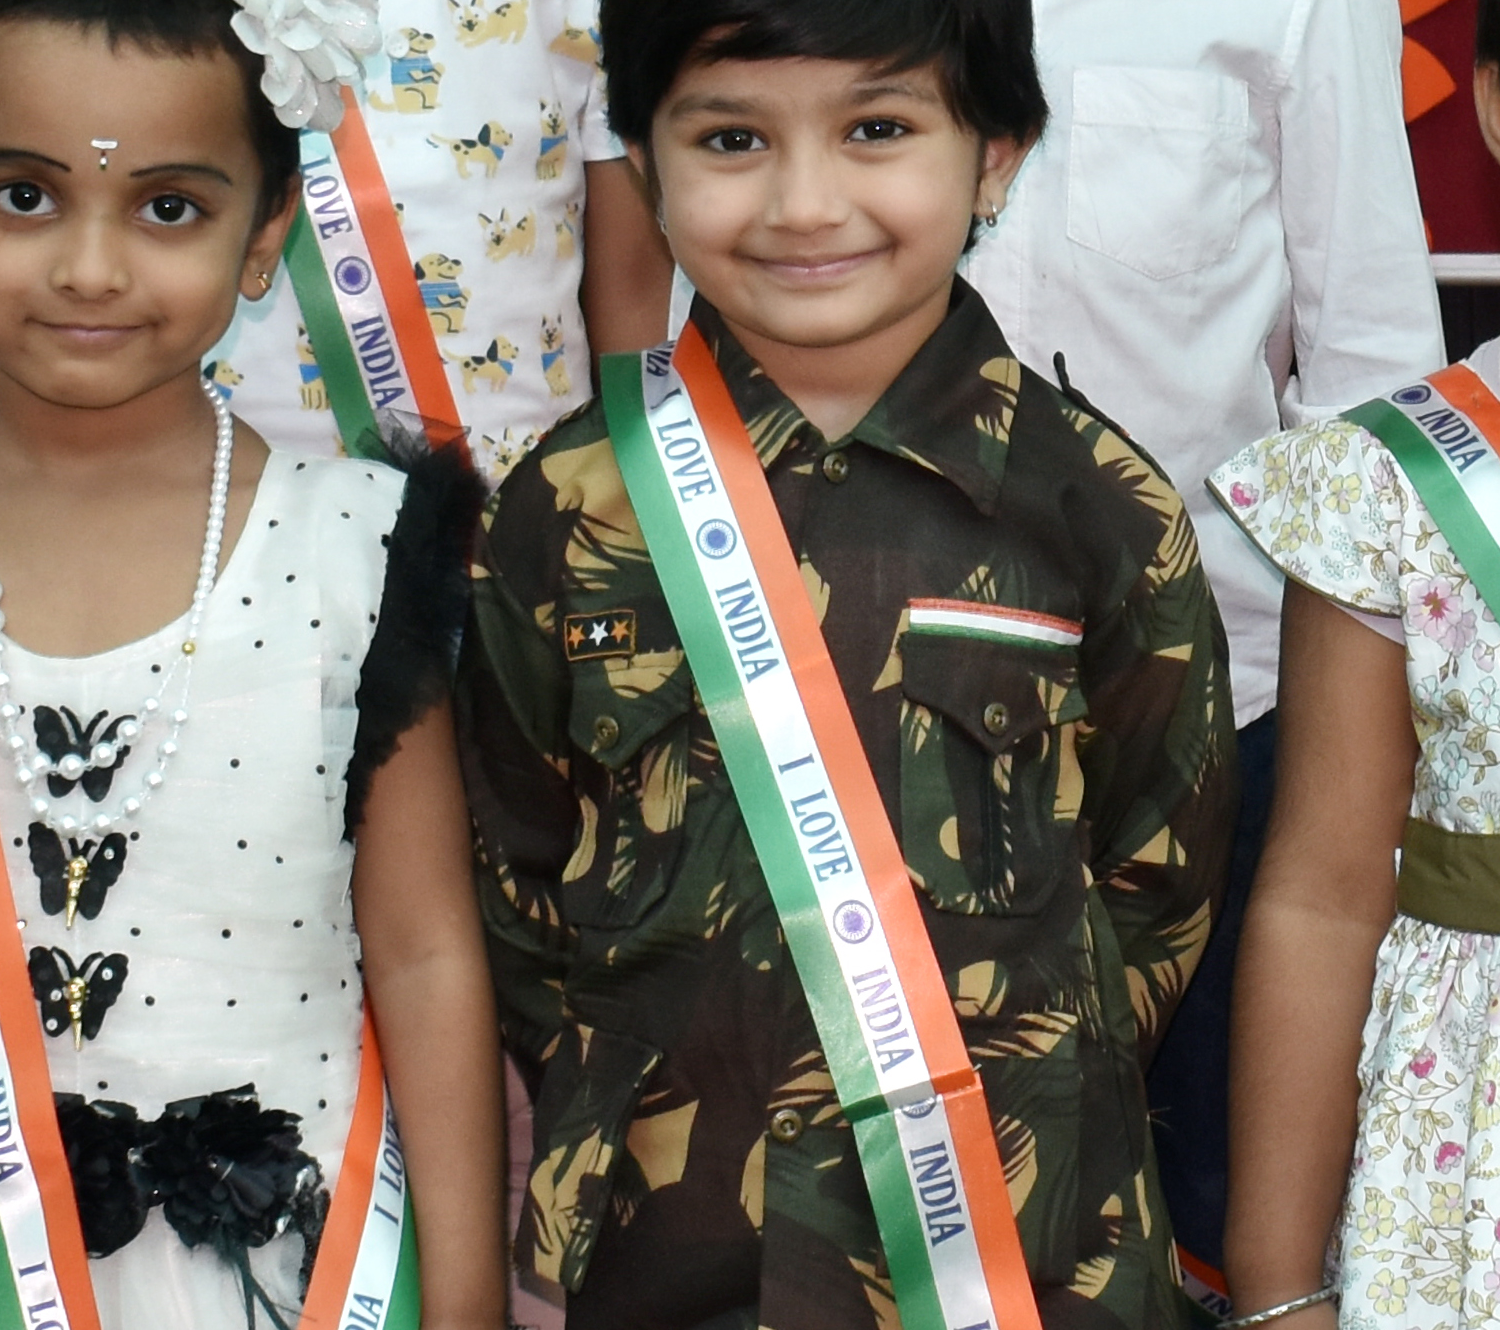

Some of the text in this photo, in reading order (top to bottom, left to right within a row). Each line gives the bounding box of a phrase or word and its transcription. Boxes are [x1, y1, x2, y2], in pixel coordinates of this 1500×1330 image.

[301, 156, 406, 408] LOVE INDIA
[1416, 408, 1491, 474] INDIA
[656, 417, 717, 503] LOVE
[715, 578, 782, 686] INDIA
[777, 751, 916, 1075] I LOVE INDIA
[374, 1202, 399, 1227] I
[909, 1140, 968, 1249] INDIA
[18, 1261, 47, 1280] I
